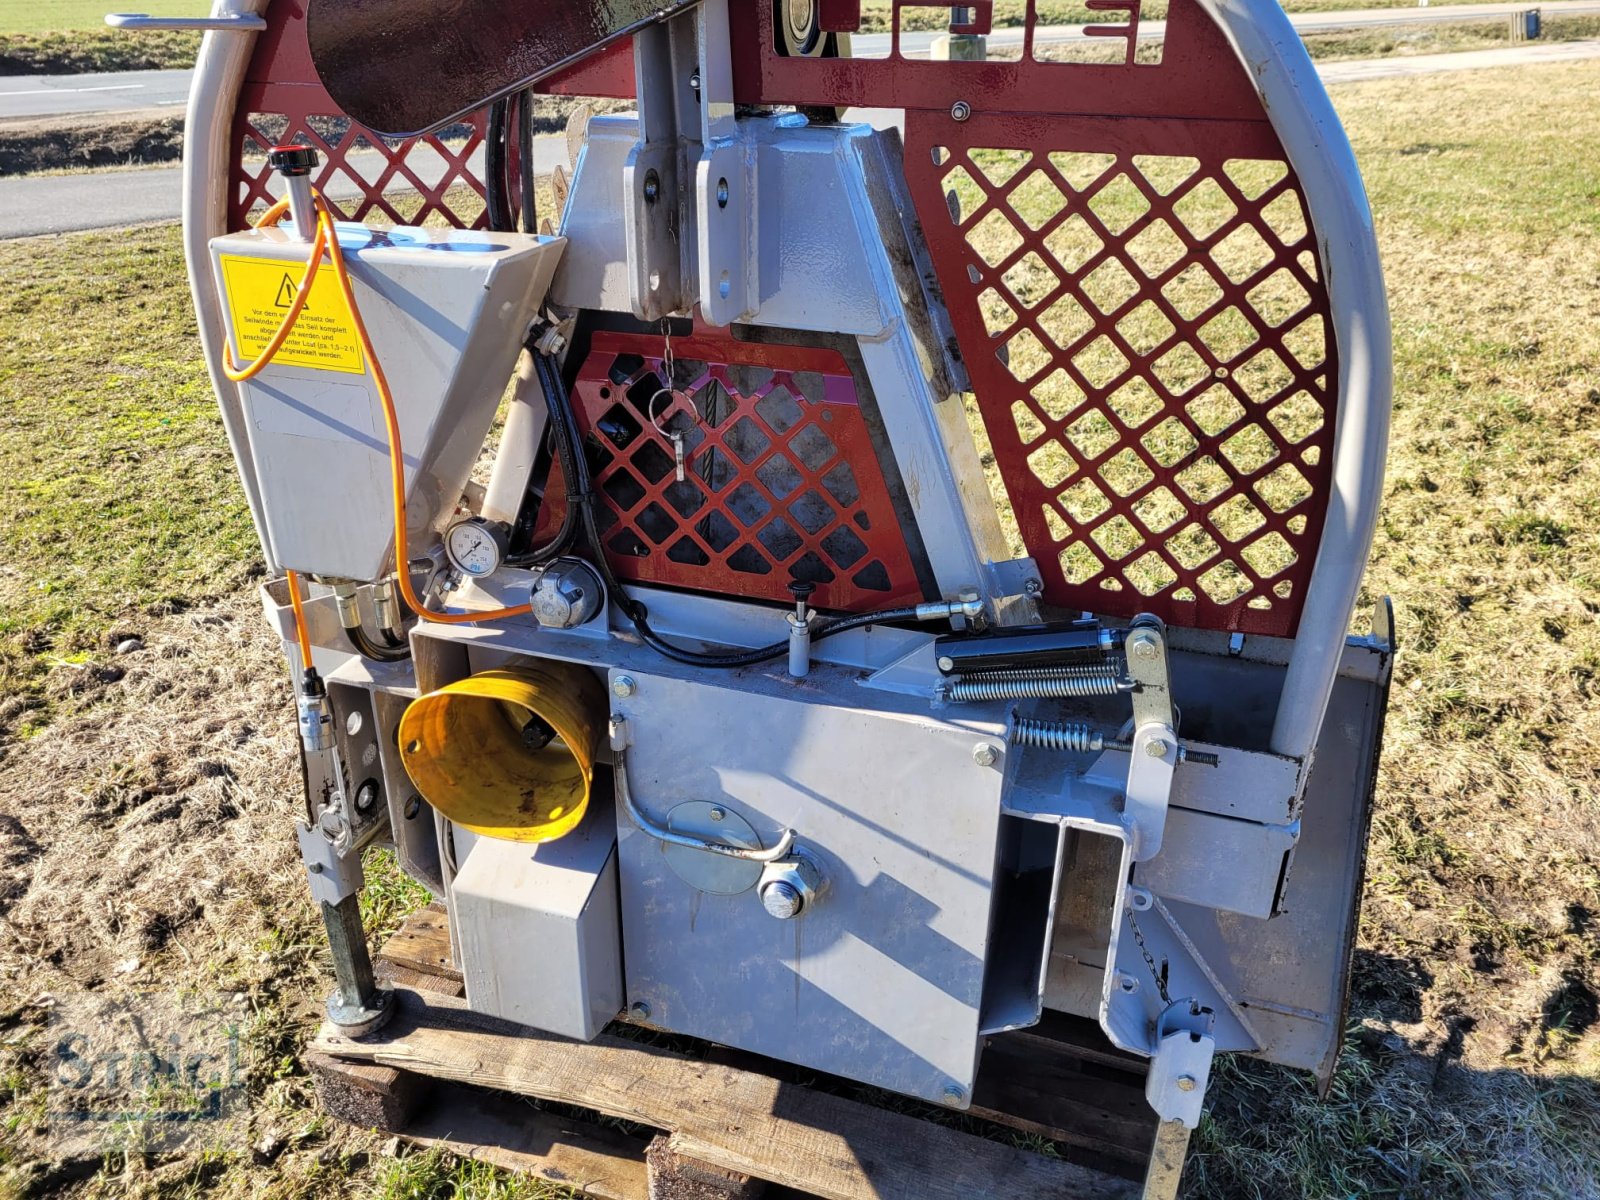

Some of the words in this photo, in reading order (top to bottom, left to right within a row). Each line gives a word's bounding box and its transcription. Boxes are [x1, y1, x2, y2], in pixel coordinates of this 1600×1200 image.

[300, 314, 323, 322] Einsatz
[244, 316, 274, 325] Seilwinde
[320, 325, 347, 334] komplett
